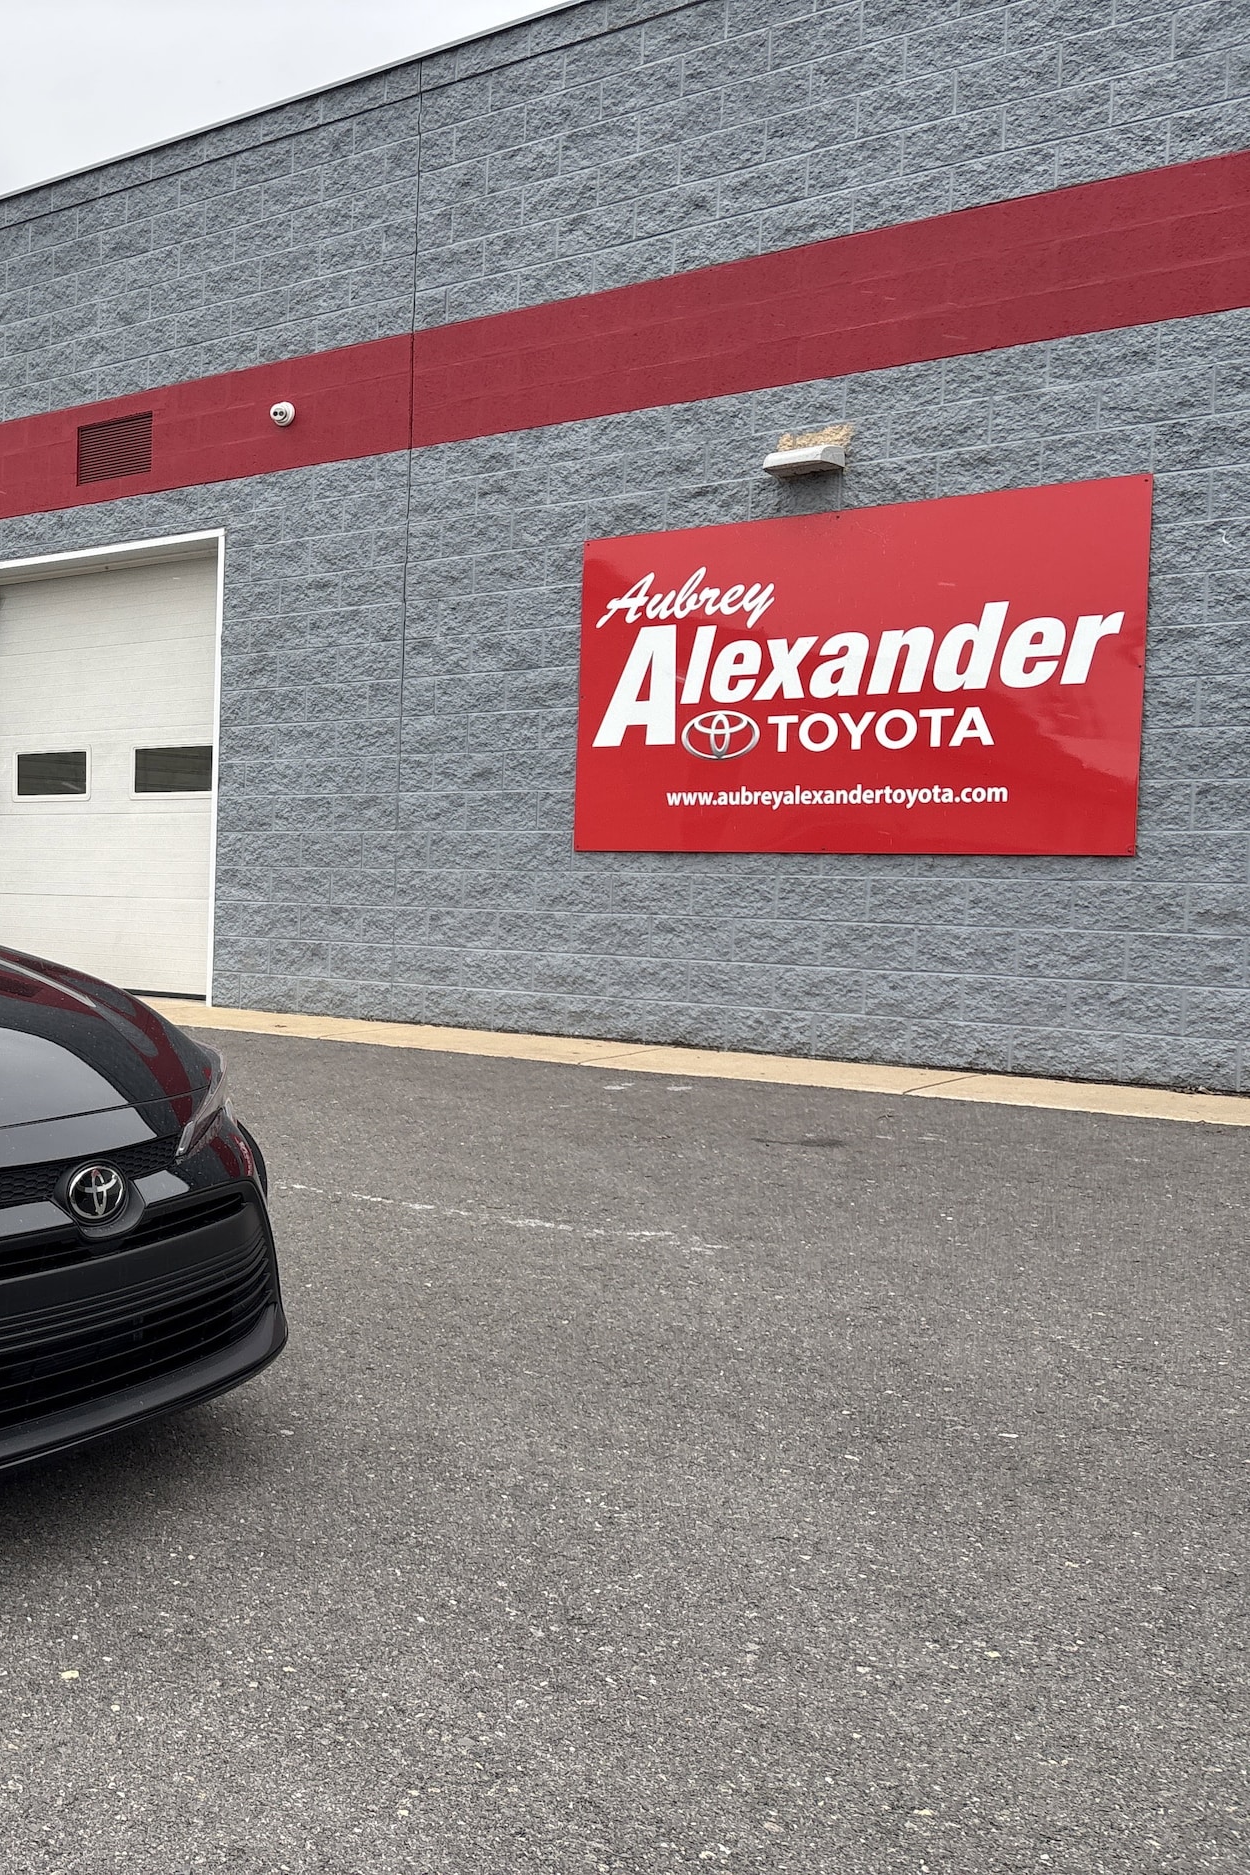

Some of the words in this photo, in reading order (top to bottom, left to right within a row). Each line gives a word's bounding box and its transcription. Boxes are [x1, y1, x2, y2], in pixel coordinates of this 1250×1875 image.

[595, 566, 775, 629] Aubrey
[592, 600, 1125, 748] Alexander
[767, 706, 995, 753] TOYOTA
[666, 783, 1009, 811] www.aubreyalexandertoyota.com
